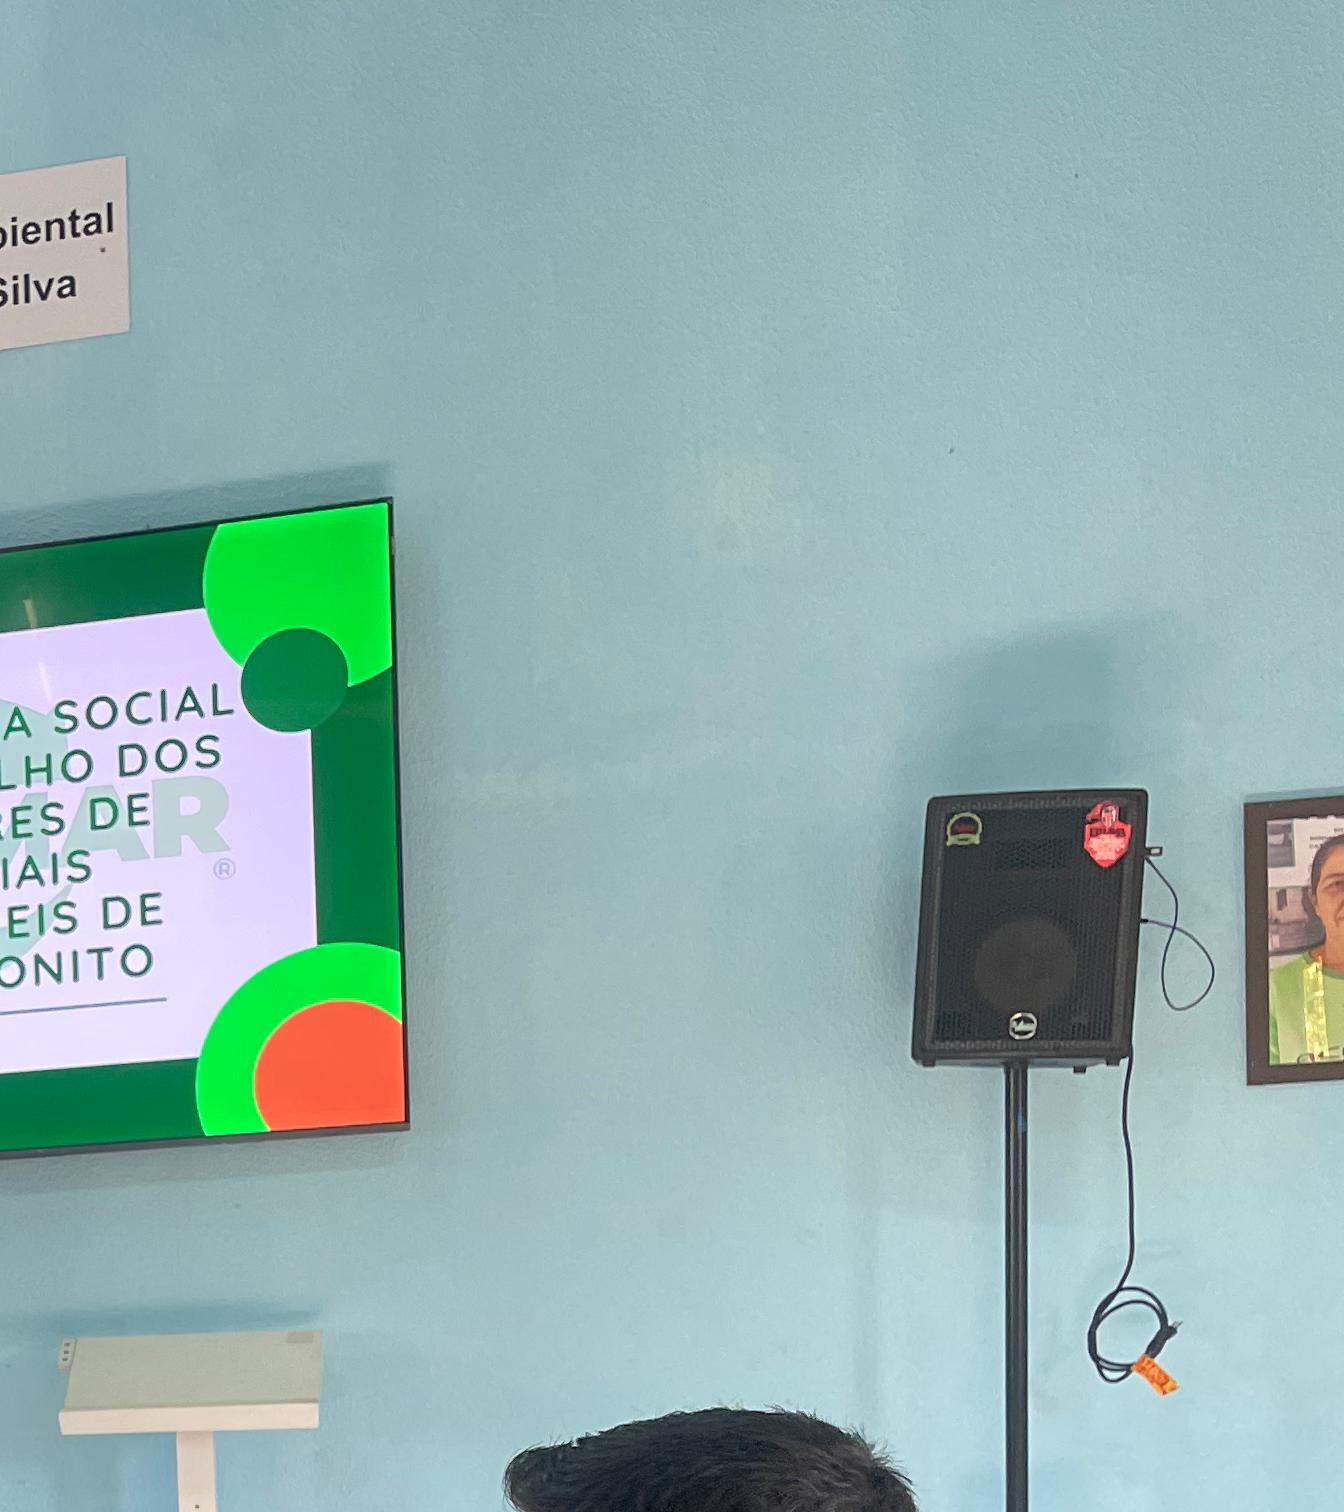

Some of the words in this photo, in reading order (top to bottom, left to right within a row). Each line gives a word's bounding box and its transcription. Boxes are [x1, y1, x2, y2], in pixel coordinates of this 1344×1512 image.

[53, 683, 234, 735] SOCIAL
[117, 735, 221, 778] DOS
[89, 792, 151, 833] DE
[102, 892, 163, 930] DE
